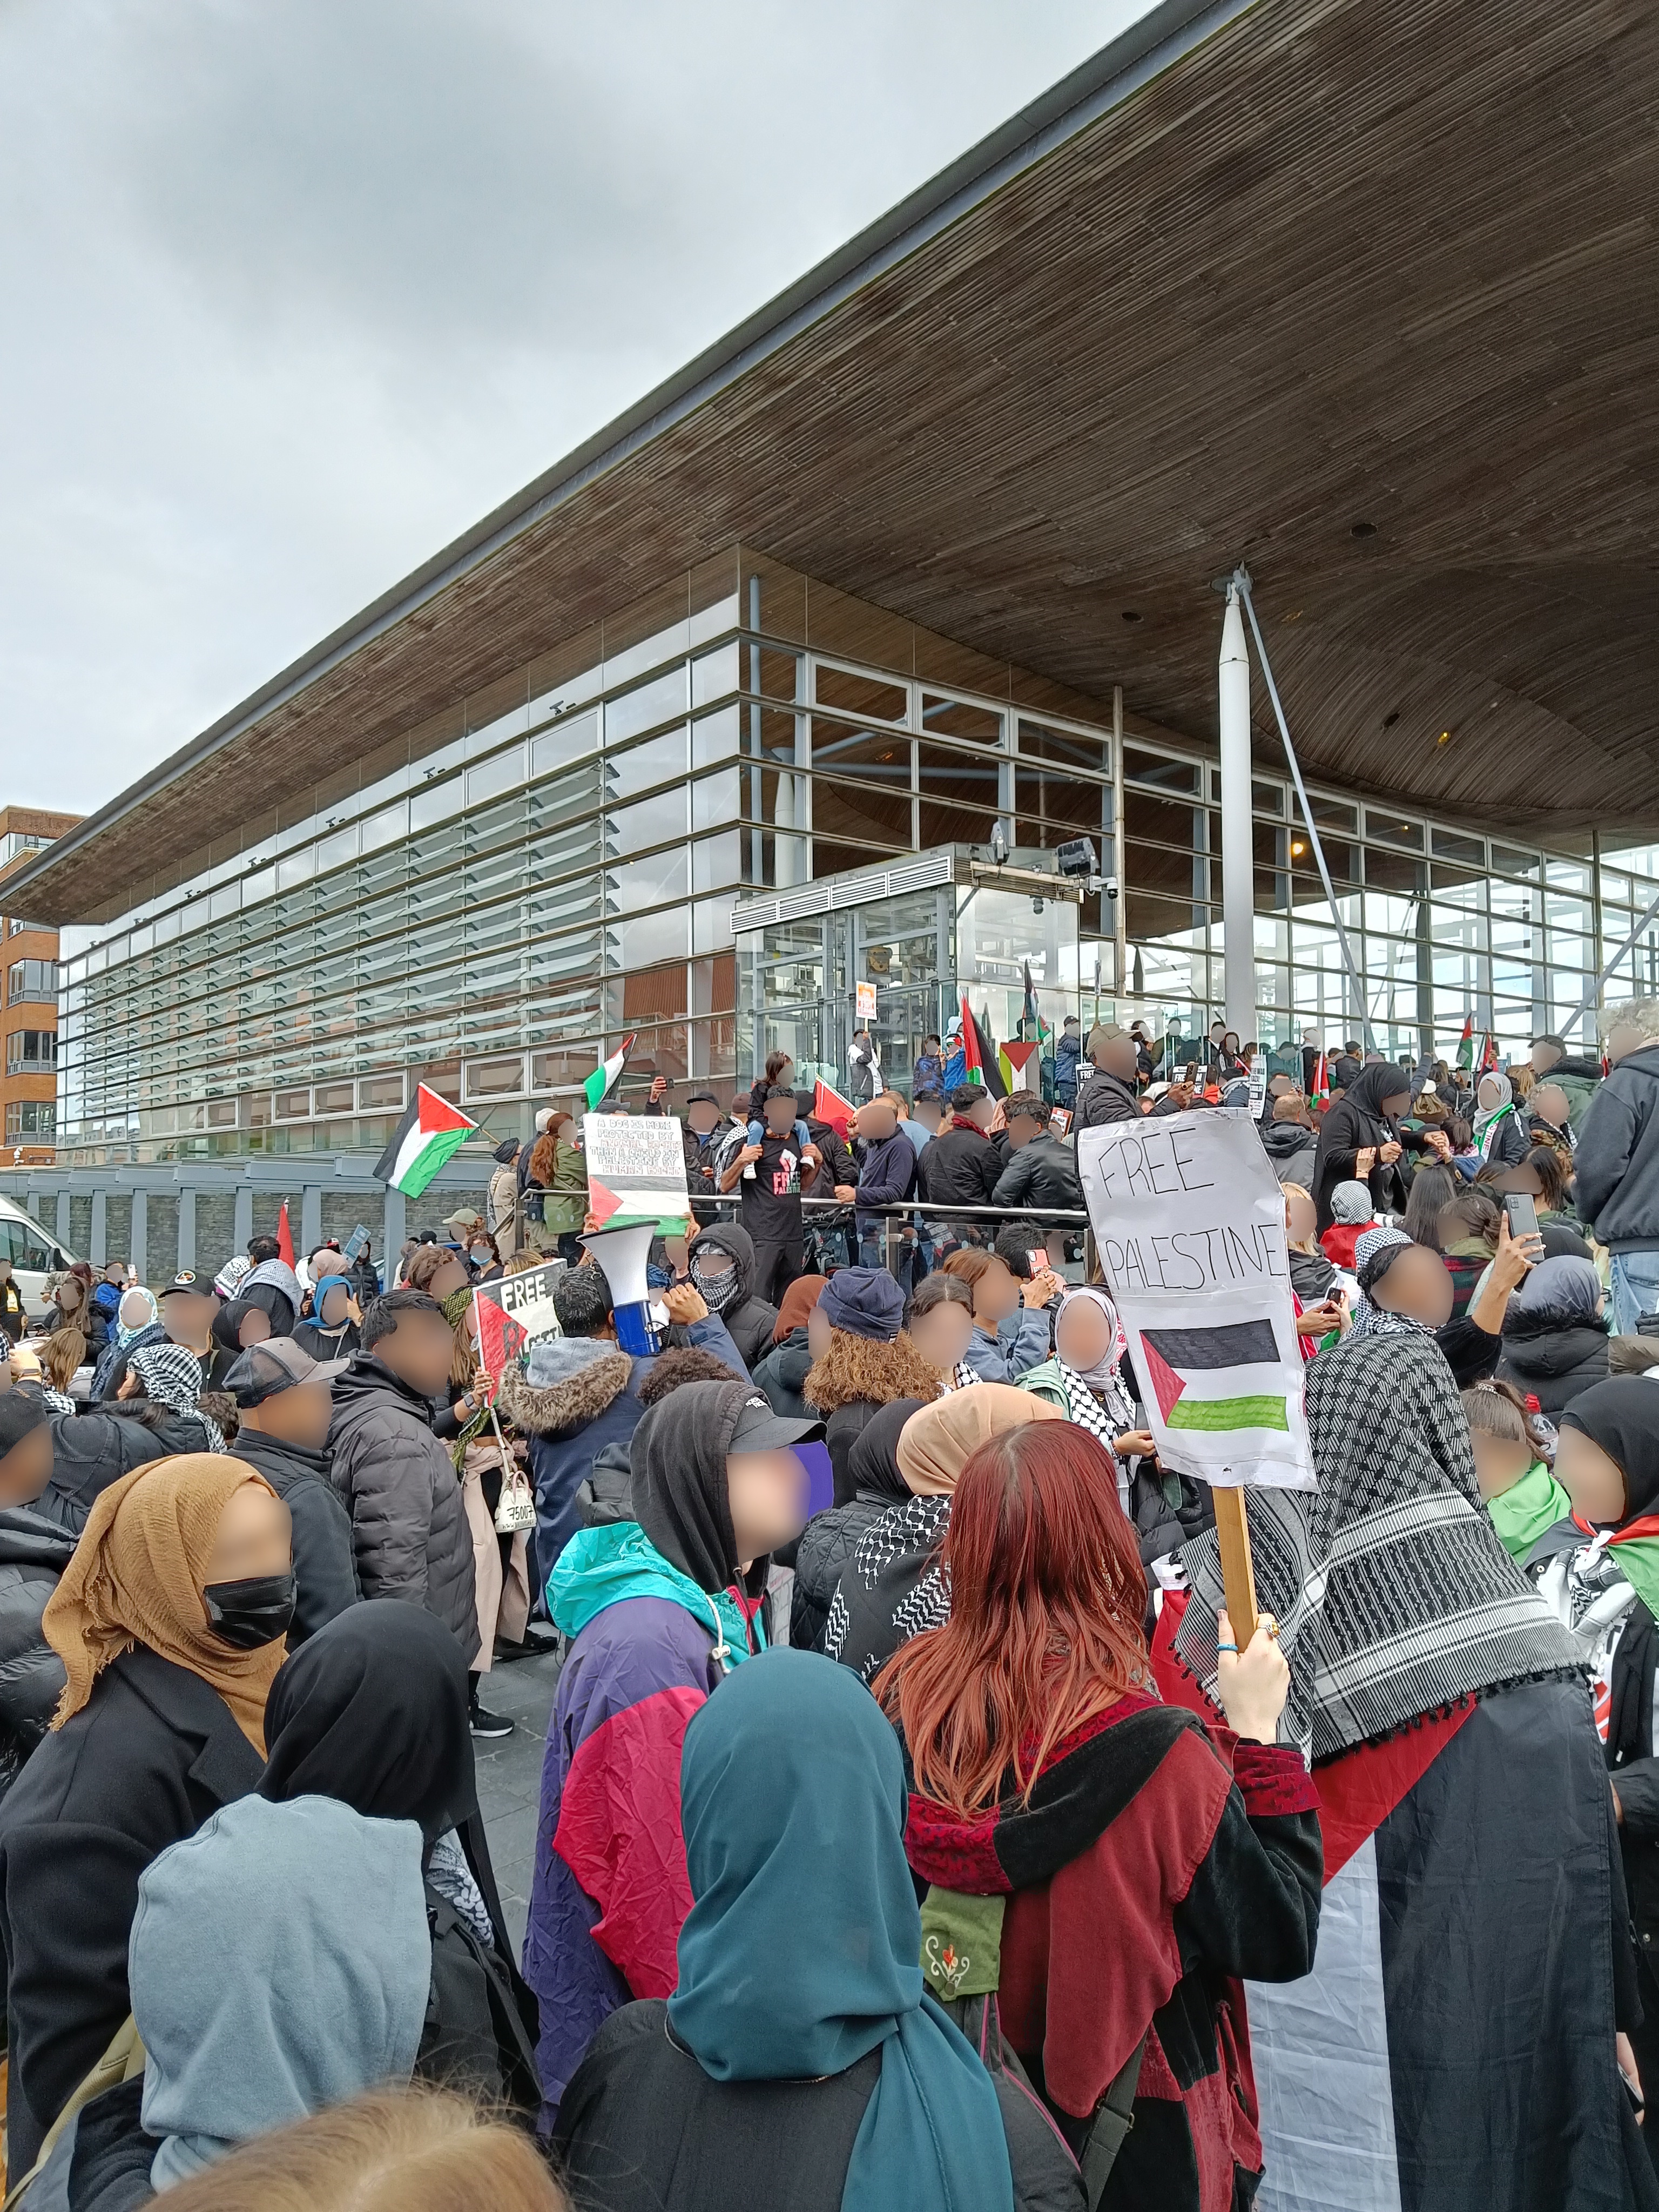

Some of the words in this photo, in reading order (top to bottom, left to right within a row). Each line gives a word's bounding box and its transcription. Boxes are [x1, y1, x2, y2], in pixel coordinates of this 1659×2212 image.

[598, 1118, 605, 1127] A
[610, 1120, 629, 1128] DOG
[631, 1120, 644, 1129] IS
[646, 1121, 671, 1129] MORE
[598, 1129, 654, 1139] PROTECTED
[658, 1131, 674, 1140] BY
[601, 1139, 643, 1148] ANIMAL
[648, 1140, 682, 1150] RIGHTS
[590, 1147, 616, 1156] THAN
[619, 1148, 625, 1157] A
[629, 1148, 661, 1157] CHILD
[663, 1149, 679, 1158] IN
[598, 1156, 658, 1166] PALESTINE
[662, 1157, 677, 1166] BY
[1098, 1128, 1215, 1198] FREE
[603, 1165, 643, 1175] HUMAN
[647, 1166, 684, 1176] RIGHTS
[773, 1171, 801, 1186] FREE
[774, 1186, 801, 1195] PALESTINE
[1105, 1224, 1287, 1291] PALESTINE
[501, 1273, 546, 1311] FREE
[507, 1506, 534, 1520] 75007
